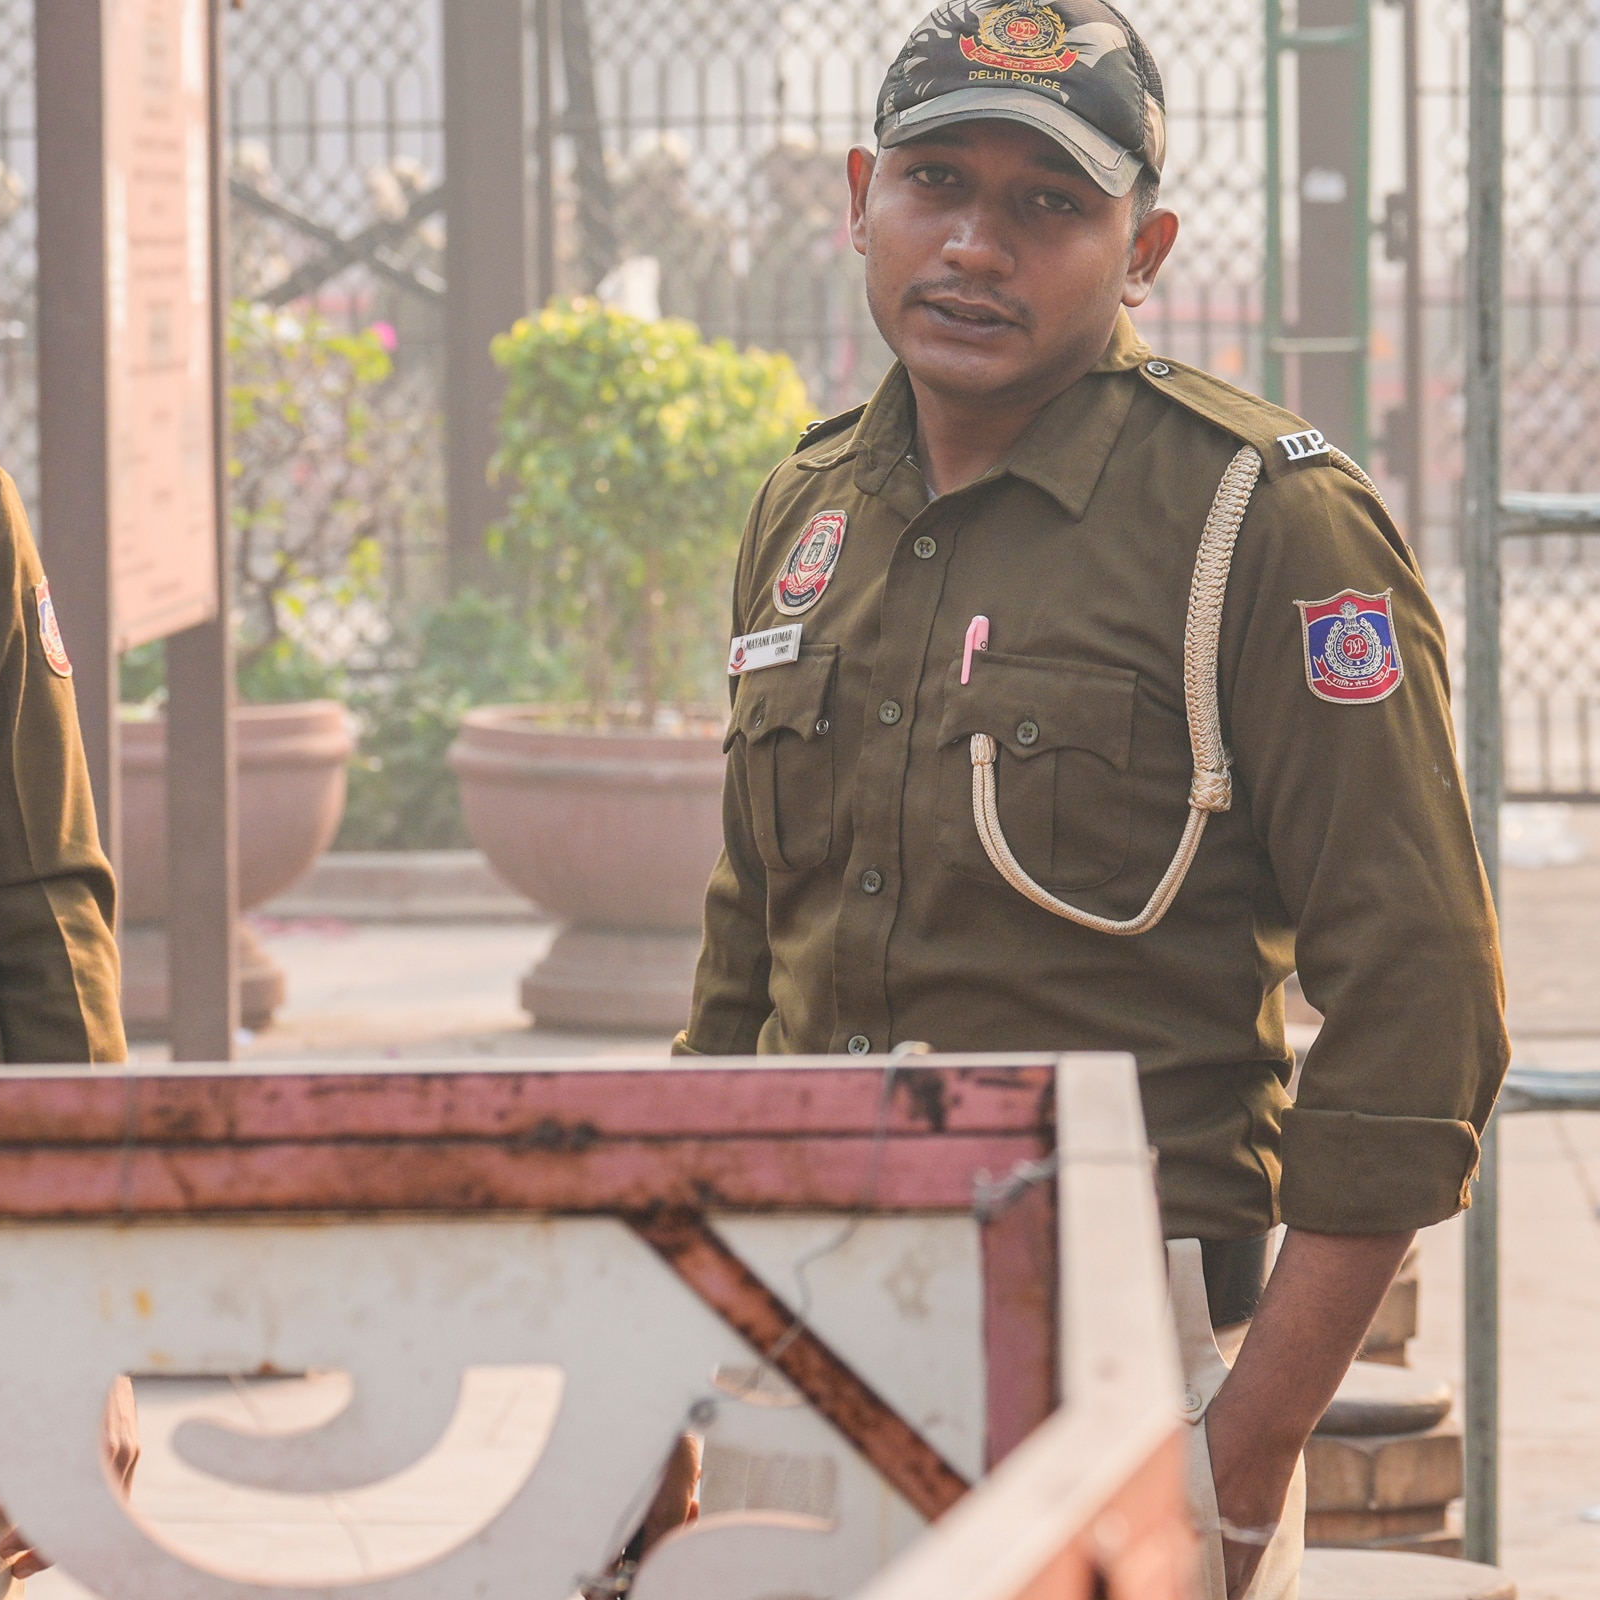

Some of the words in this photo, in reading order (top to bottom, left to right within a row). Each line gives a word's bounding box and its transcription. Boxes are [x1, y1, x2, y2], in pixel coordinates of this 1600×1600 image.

[969, 70, 1007, 81] DELHI
[1011, 71, 1061, 91] POLICE
[1277, 430, 1329, 461] DP
[746, 635, 770, 649] MAYANK
[771, 630, 792, 644] KUMAR
